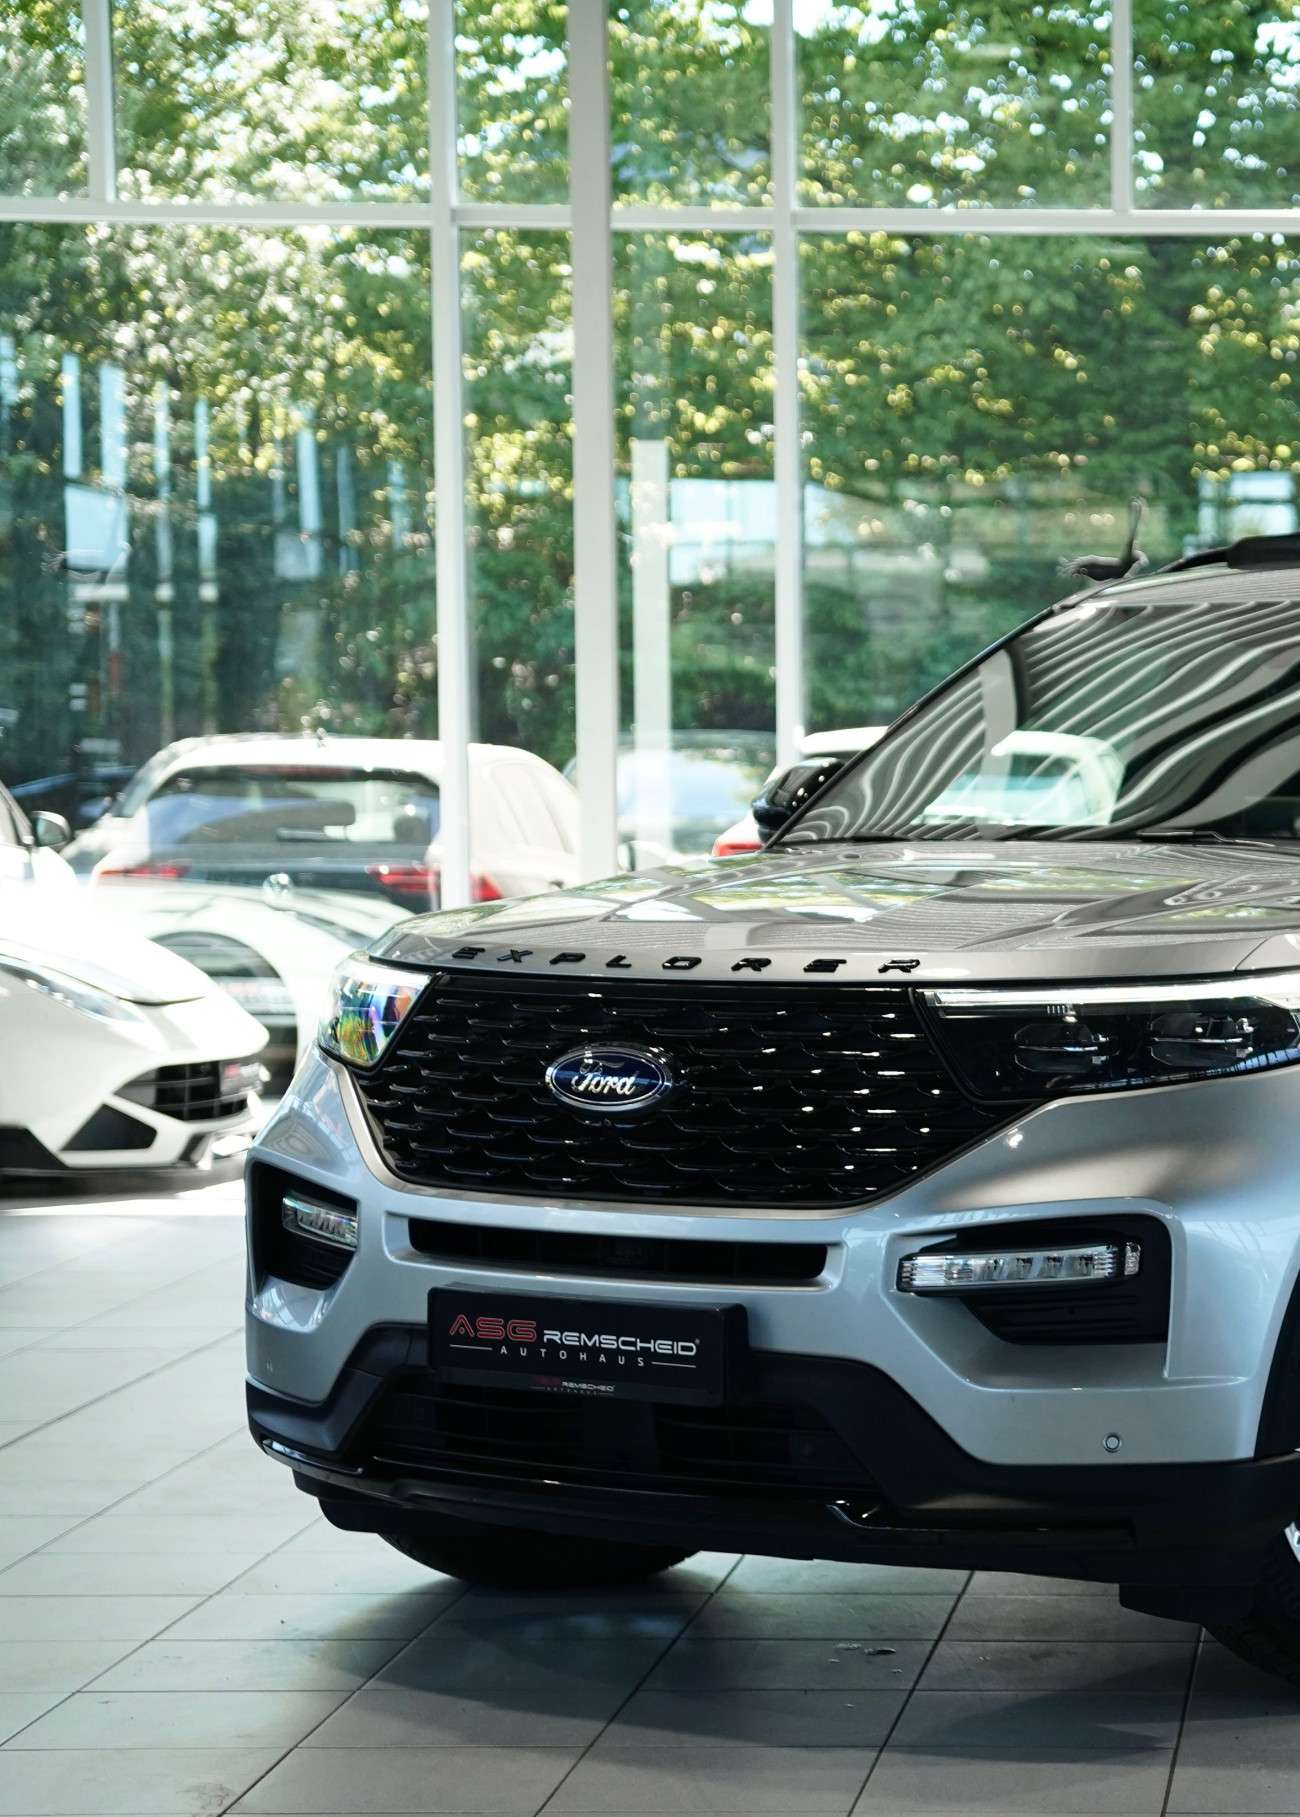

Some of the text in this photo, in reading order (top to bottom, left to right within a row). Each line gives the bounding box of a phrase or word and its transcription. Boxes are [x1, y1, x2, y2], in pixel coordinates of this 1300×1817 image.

[451, 946, 922, 974] EXPLORER
[571, 1058, 639, 1095] Ford
[449, 1314, 697, 1356] ASG REMSCHEID
[500, 1345, 645, 1366] AUTOHAUS
